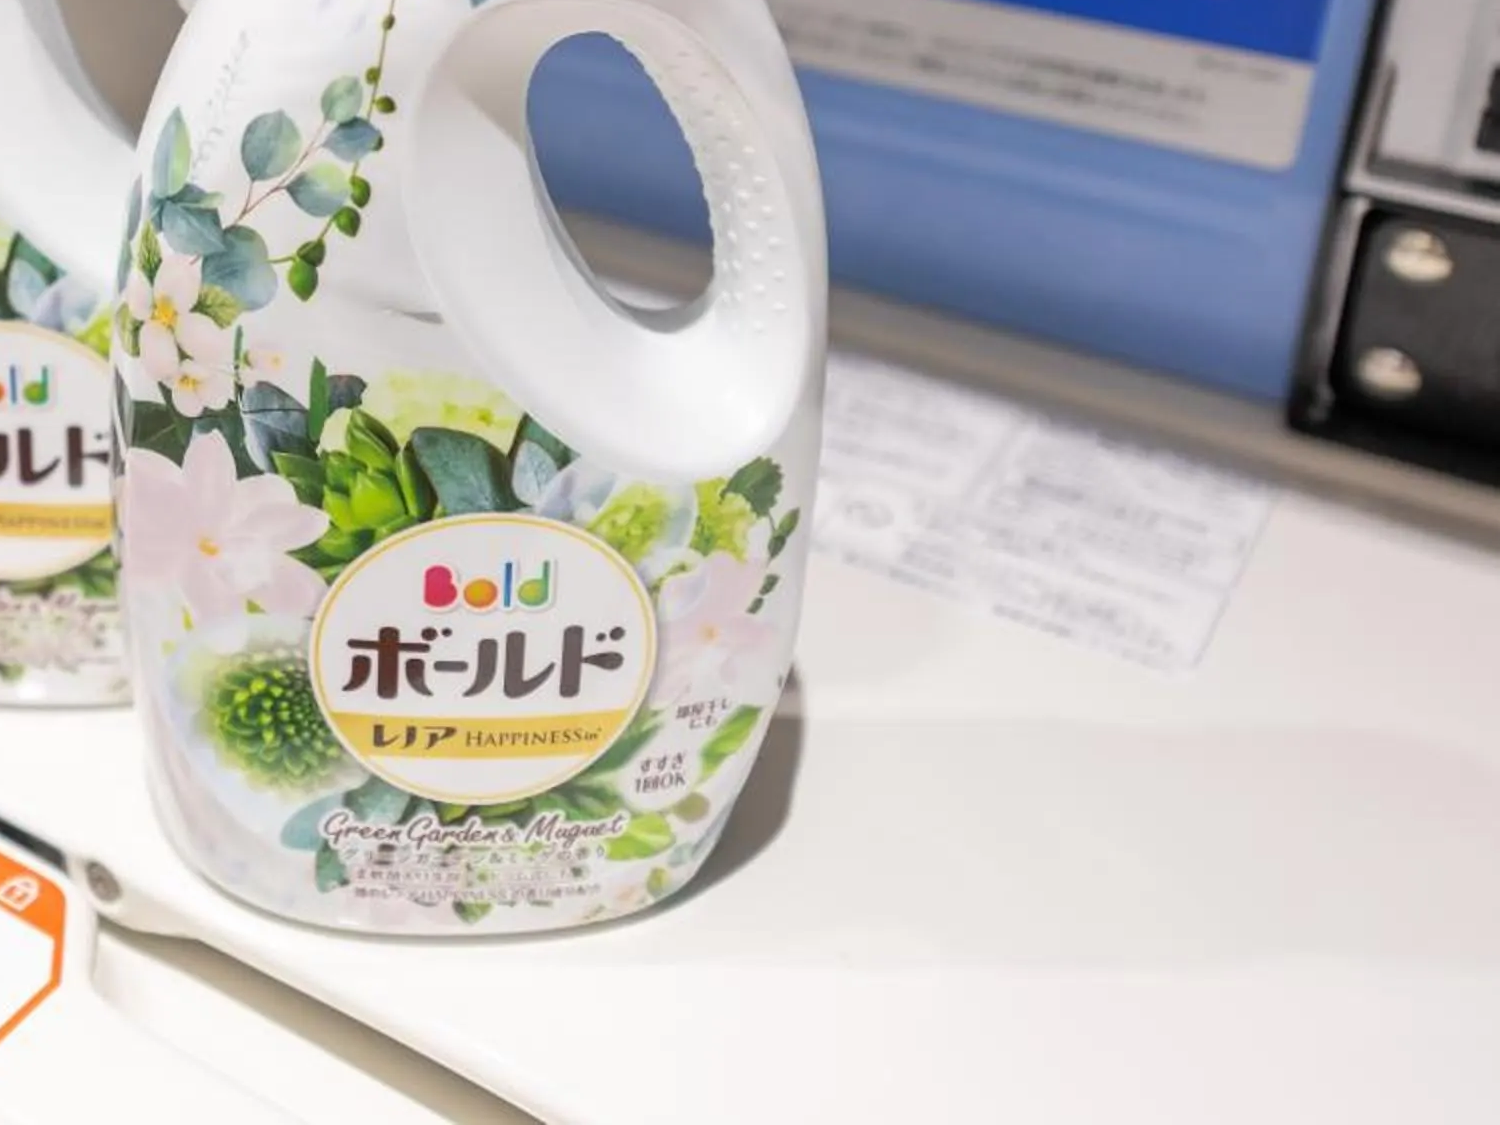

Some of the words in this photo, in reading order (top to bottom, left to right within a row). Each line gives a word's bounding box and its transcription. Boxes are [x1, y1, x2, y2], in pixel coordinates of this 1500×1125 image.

[424, 560, 550, 608] Bold
[341, 625, 626, 699] ボールド
[373, 724, 457, 749] レノア
[324, 811, 402, 849] Green
[407, 816, 500, 851] Garden
[525, 813, 625, 850] Muguet
